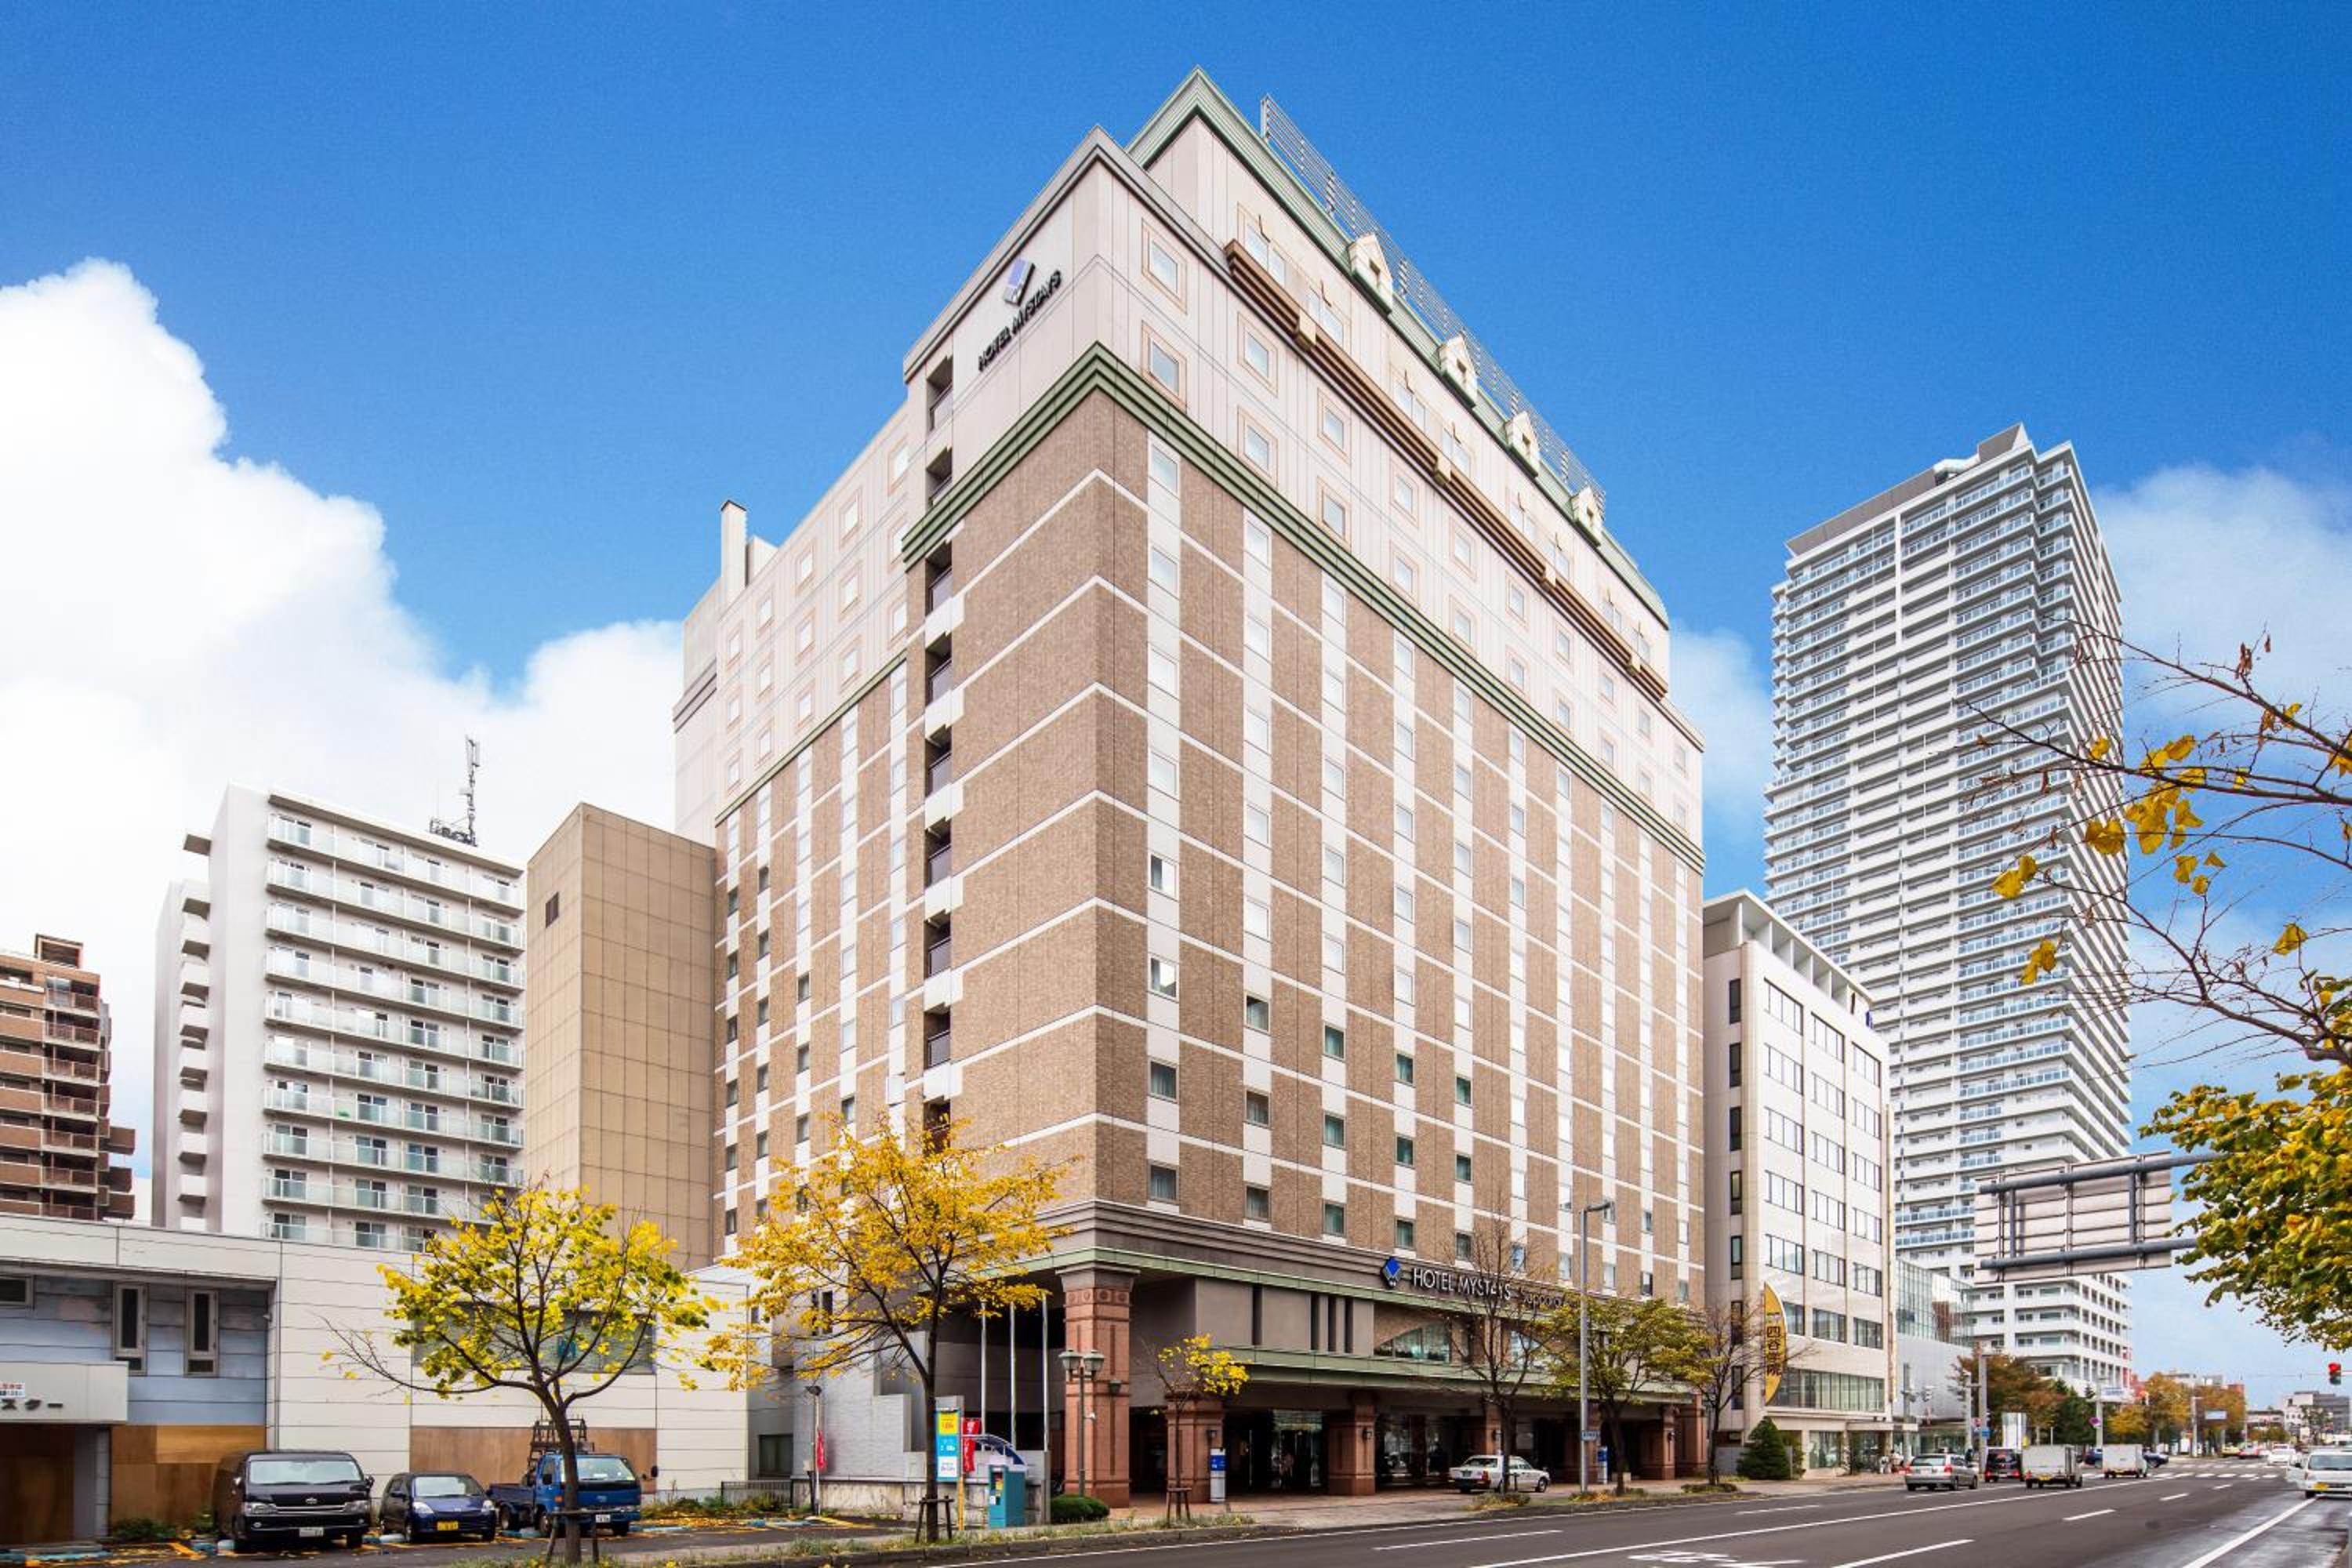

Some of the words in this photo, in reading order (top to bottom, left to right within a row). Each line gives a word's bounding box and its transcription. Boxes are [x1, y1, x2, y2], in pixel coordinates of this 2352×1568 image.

[978, 326, 1011, 372] HOTEL
[1012, 270, 1062, 335] MYSTAYS
[1413, 1268, 1454, 1292] HOTEL
[1458, 1276, 1512, 1301] MYSTAYS
[1766, 1326, 1782, 1377] 四谷学院
